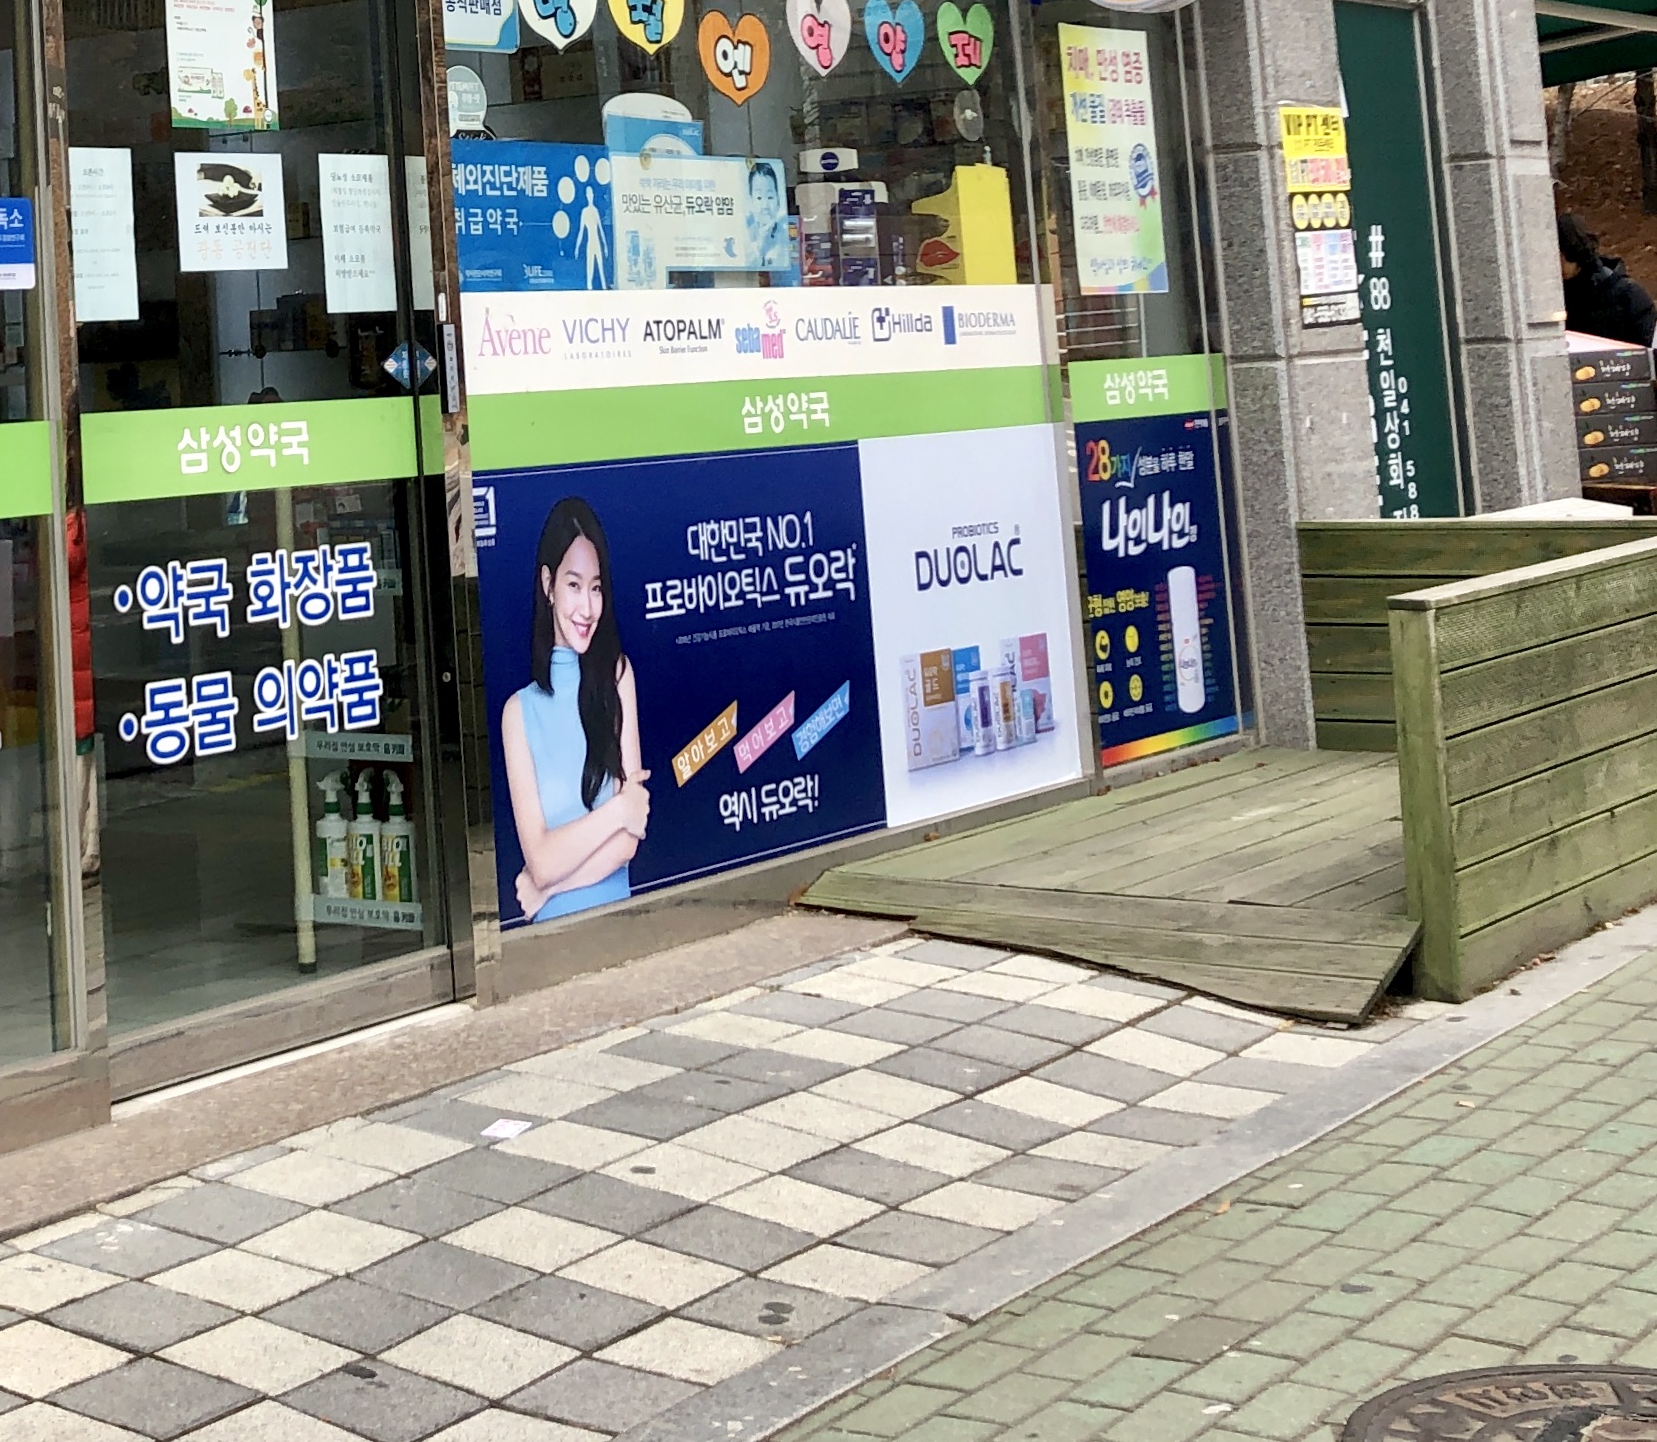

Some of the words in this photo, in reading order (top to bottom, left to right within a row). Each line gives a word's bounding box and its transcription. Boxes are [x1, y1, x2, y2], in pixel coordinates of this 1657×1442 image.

[621, 193, 652, 216] 맛있는
[562, 317, 631, 345] VICHY
[643, 318, 723, 342] ATOPALM
[958, 312, 1016, 329] BIODERMA
[741, 391, 830, 435] 삼성약국
[1103, 368, 1169, 405] 삼성약국
[1374, 327, 1404, 490] 천일상회
[177, 420, 310, 475] 삼성약국
[687, 515, 763, 563] 대한민국
[767, 510, 814, 550] NO.1
[951, 521, 999, 539] PROBIOTICS
[915, 537, 1024, 592] DUOLAC
[135, 557, 233, 644] 약국
[247, 541, 379, 630] 화장품
[644, 568, 781, 620] 프로바이오틱스
[143, 669, 240, 766] 동물
[252, 648, 384, 740] 의약품
[738, 706, 789, 763] 먹어보고
[677, 717, 731, 780] 알아보고
[719, 787, 757, 832] 역시
[761, 773, 820, 822] 듀오락!
